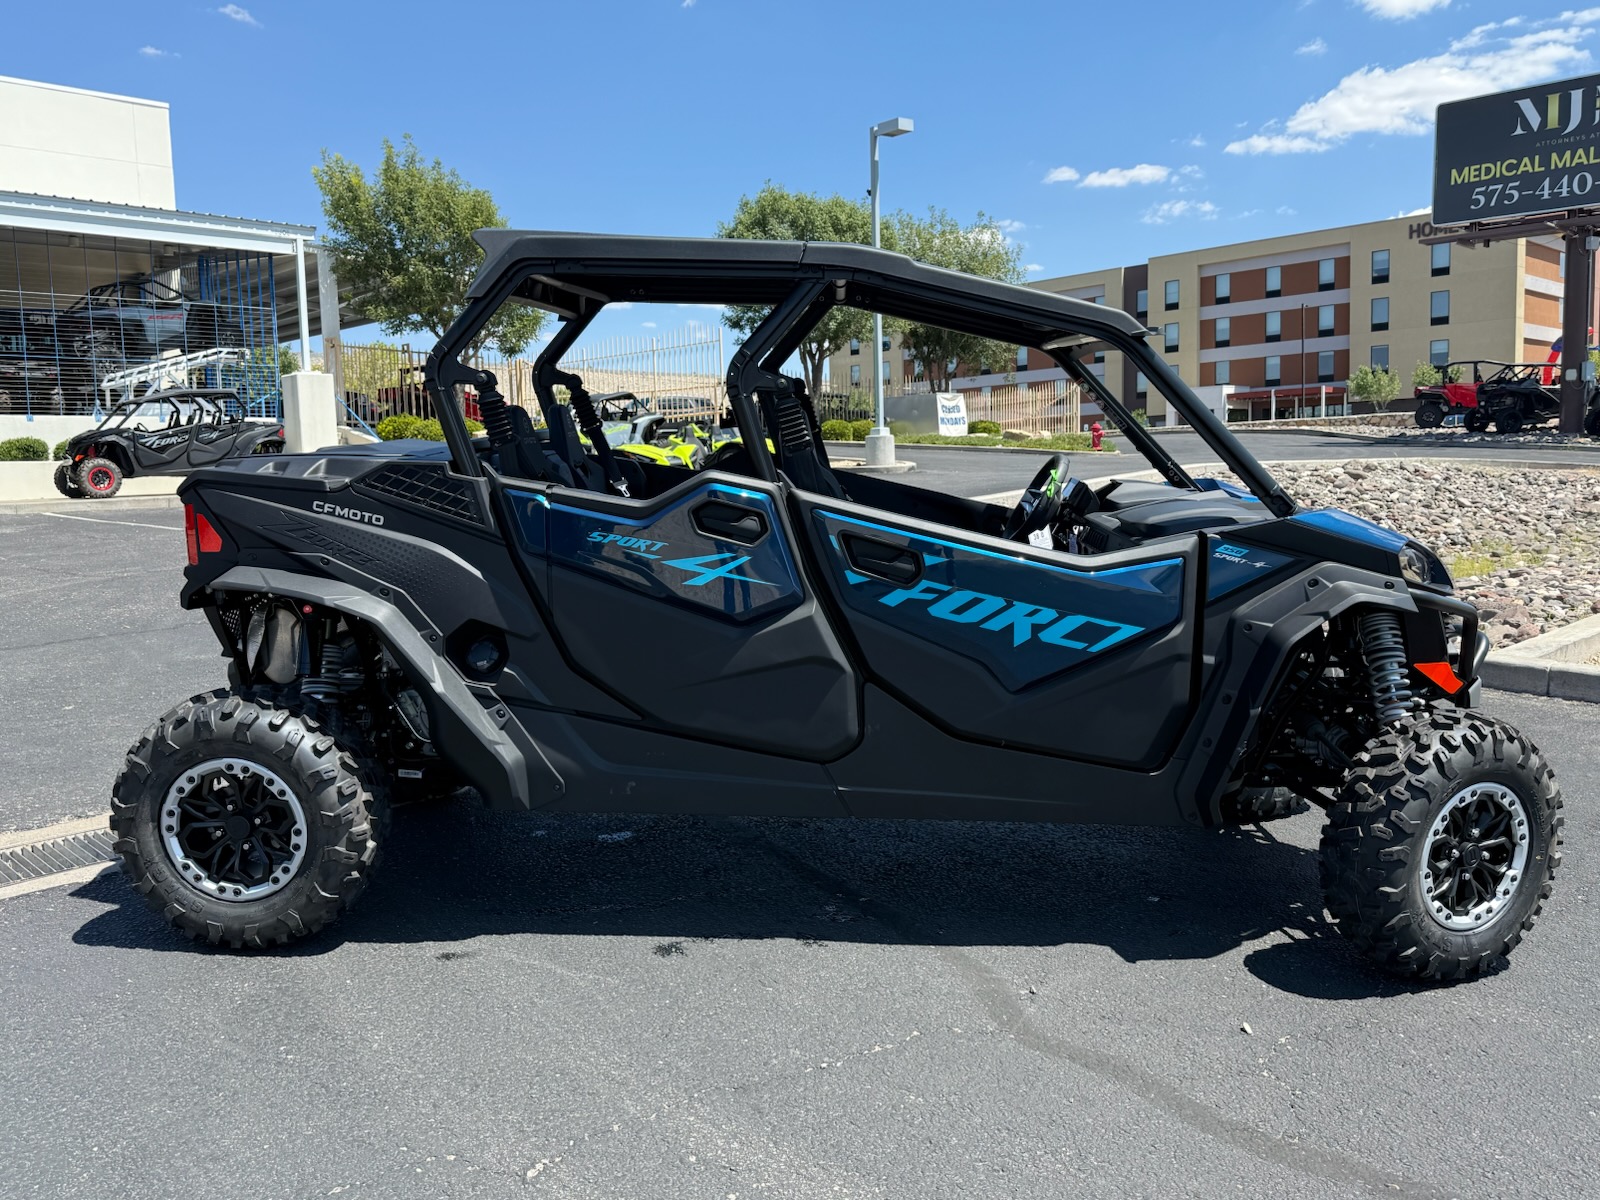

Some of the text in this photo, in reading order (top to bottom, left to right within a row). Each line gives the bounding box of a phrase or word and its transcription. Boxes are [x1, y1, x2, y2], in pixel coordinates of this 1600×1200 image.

[1535, 134, 1586, 148] ATTORNEYS
[1450, 146, 1600, 185] MEDICAL MAL
[312, 500, 385, 526] CFMOTO
[586, 530, 670, 553] SPORT
[1222, 546, 1244, 555] 950
[660, 552, 782, 586] 4
[1213, 552, 1249, 564] SPORT
